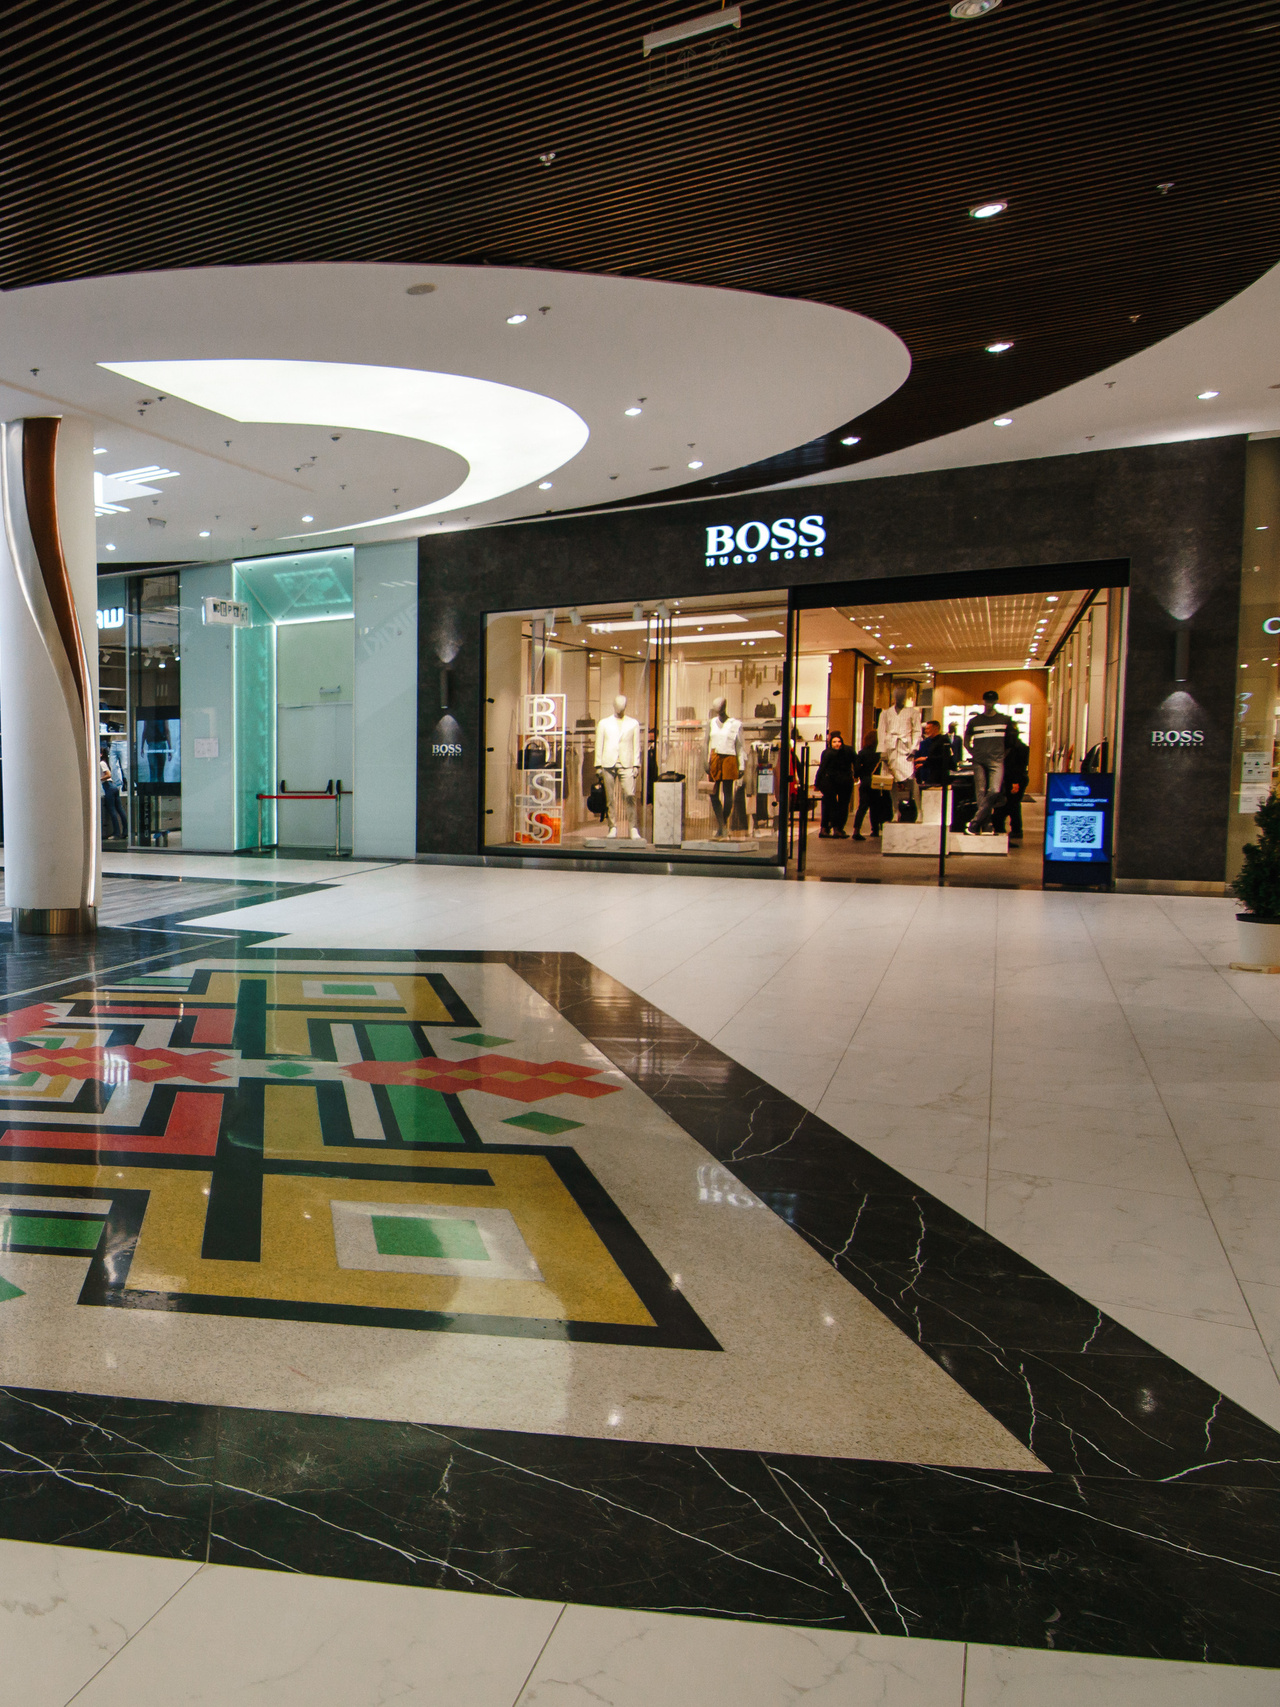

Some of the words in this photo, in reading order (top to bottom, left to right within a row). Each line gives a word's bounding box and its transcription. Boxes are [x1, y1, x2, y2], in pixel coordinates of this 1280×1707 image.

[705, 515, 826, 557] BOSS
[705, 553, 757, 567] HUGO
[769, 547, 824, 561] BOSS
[1151, 730, 1205, 743] BOSS
[432, 744, 462, 754] BOSS
